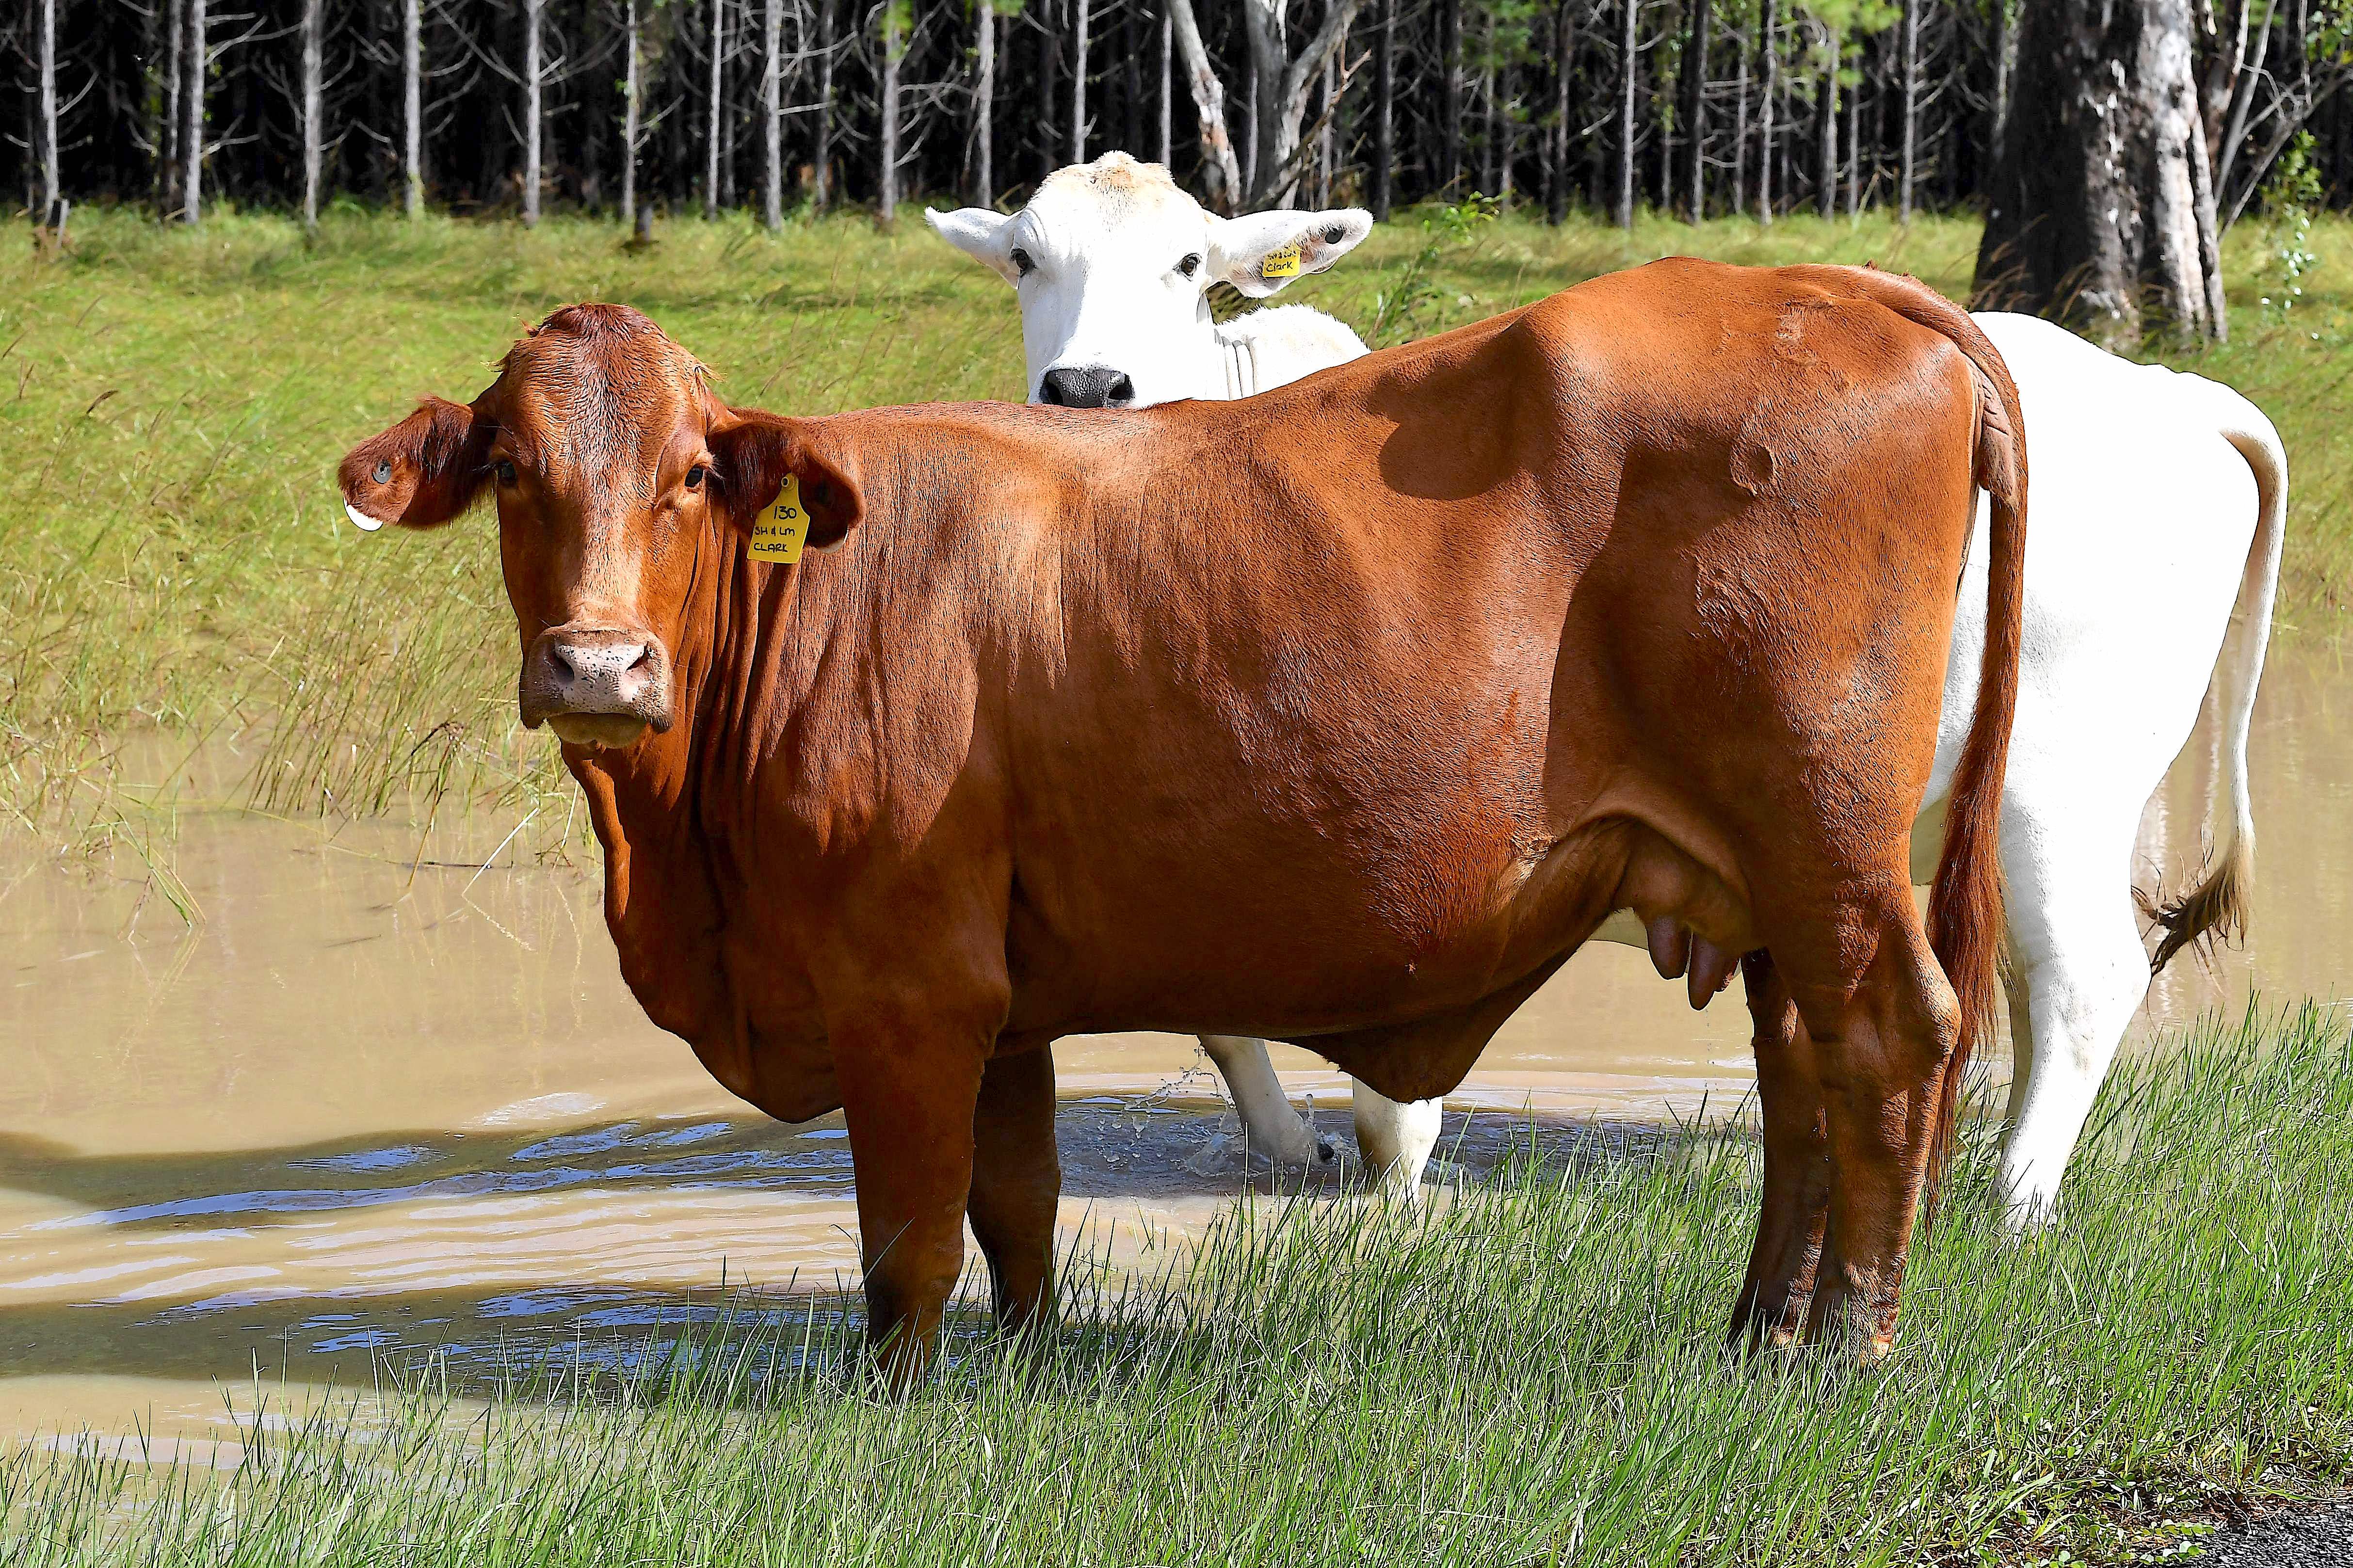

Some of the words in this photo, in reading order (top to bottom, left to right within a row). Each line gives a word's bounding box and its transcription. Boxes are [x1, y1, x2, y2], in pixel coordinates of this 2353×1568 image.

[774, 505, 797, 520] 130
[755, 527, 768, 535] SH
[753, 542, 788, 553] CLARK
